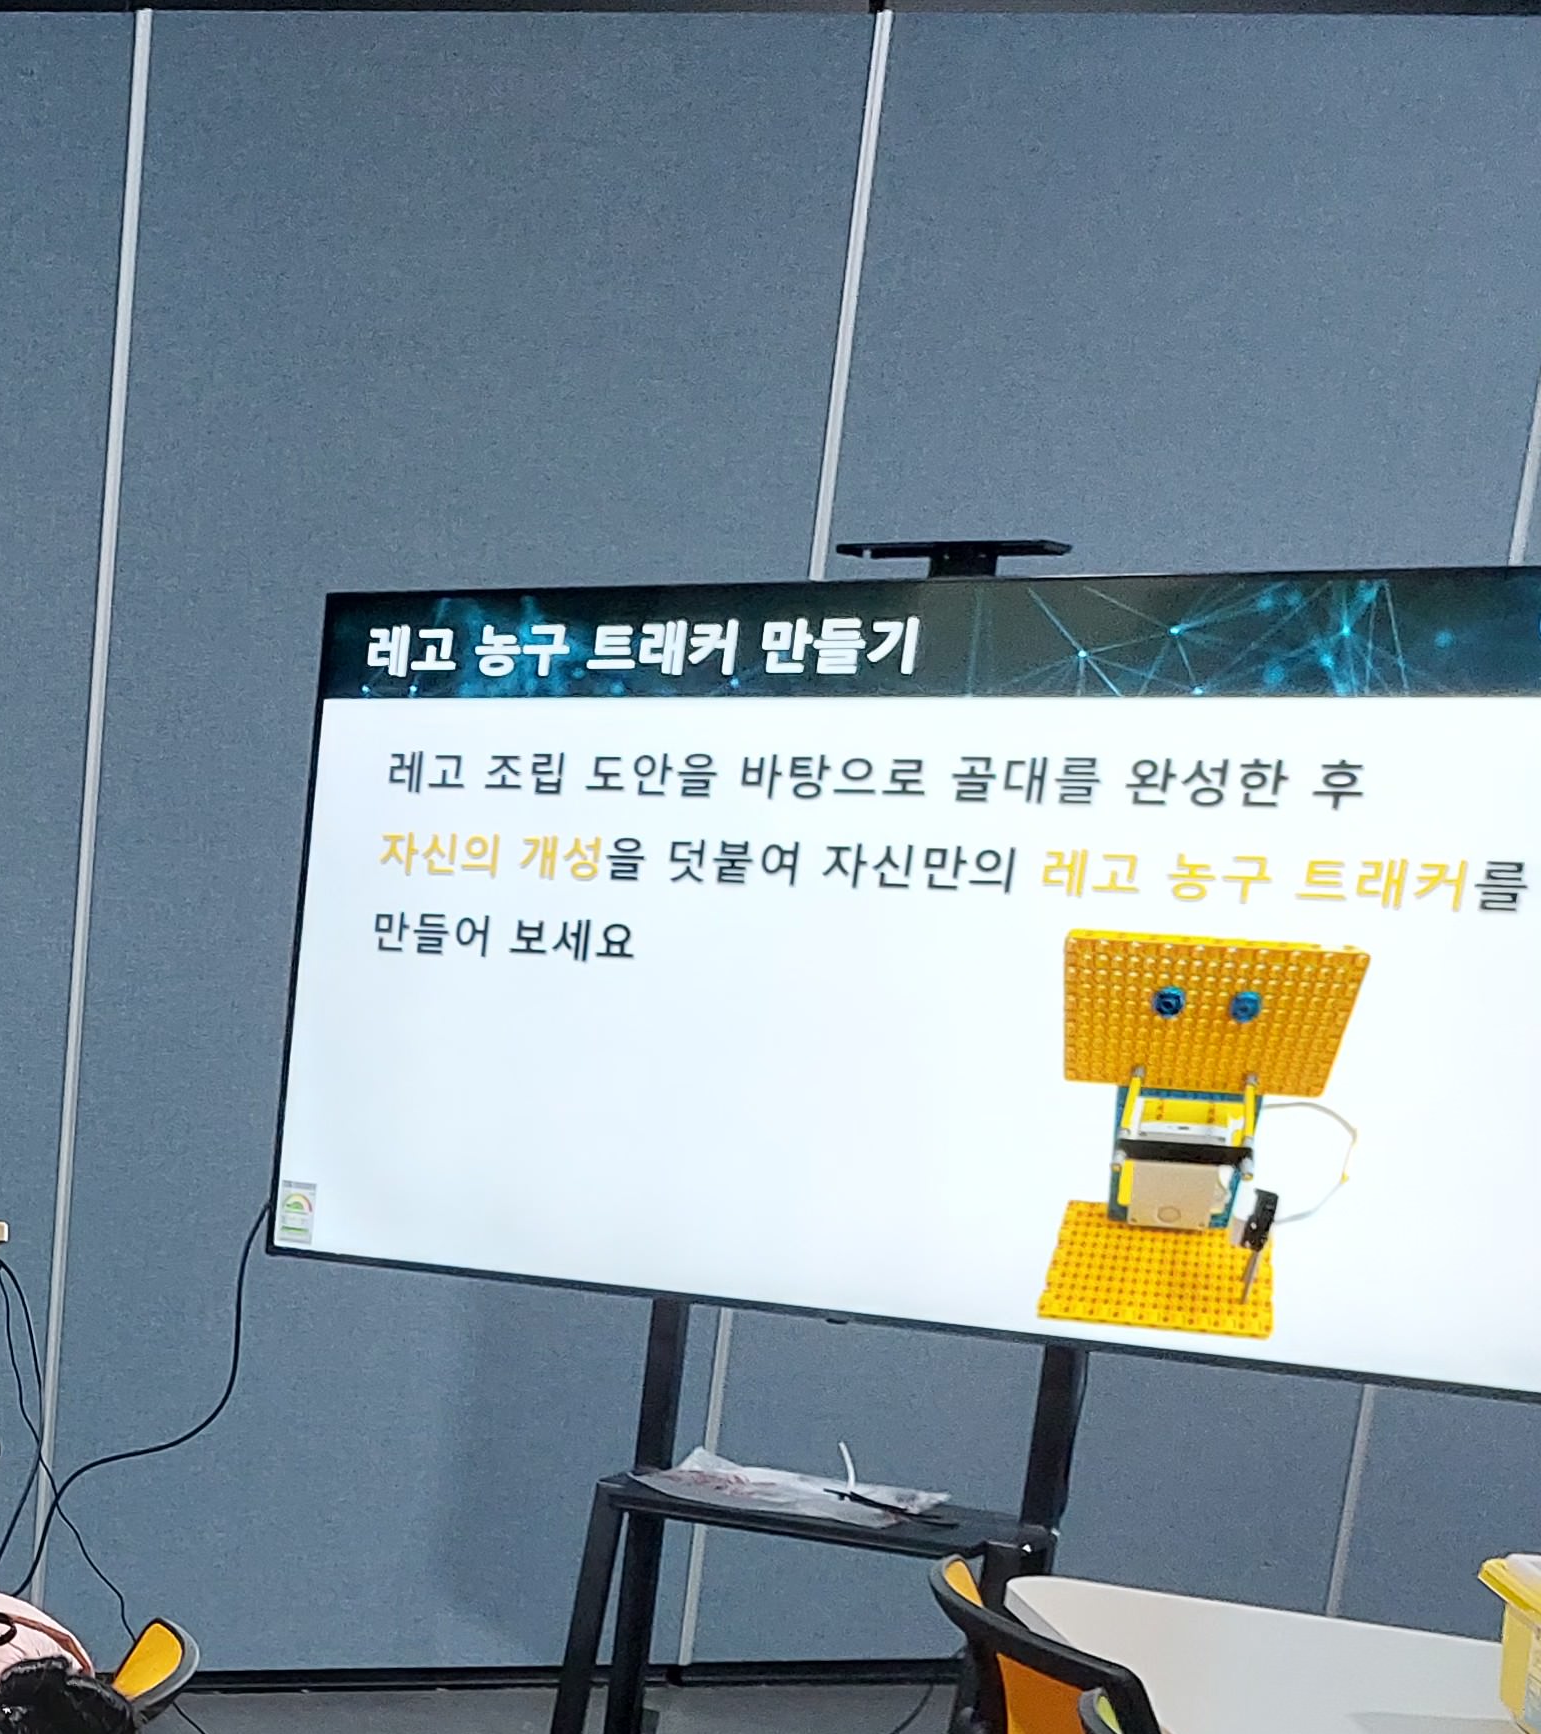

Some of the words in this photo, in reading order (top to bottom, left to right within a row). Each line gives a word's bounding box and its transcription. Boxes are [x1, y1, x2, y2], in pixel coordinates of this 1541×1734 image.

[367, 623, 457, 677] 레고
[474, 622, 570, 677] 농구
[586, 618, 739, 677] 트래커
[762, 616, 920, 676] 만들기
[388, 750, 465, 794] 레고
[484, 751, 566, 795] 조립
[585, 752, 718, 797] 도안을
[741, 753, 926, 800] 바탕으로
[951, 755, 1101, 805] 골대를
[1125, 757, 1289, 809] 완성한
[1313, 758, 1365, 811] 후
[379, 831, 501, 880] 자신의
[520, 834, 645, 882] 개성을
[668, 838, 801, 886] 덧붙여
[823, 841, 1016, 893] 자신만의
[1040, 847, 1141, 899] 레고
[1168, 852, 1272, 904] 농구
[1296, 857, 1528, 912] 트래커를
[374, 911, 491, 958] 만들어
[509, 919, 635, 962] 보세요
